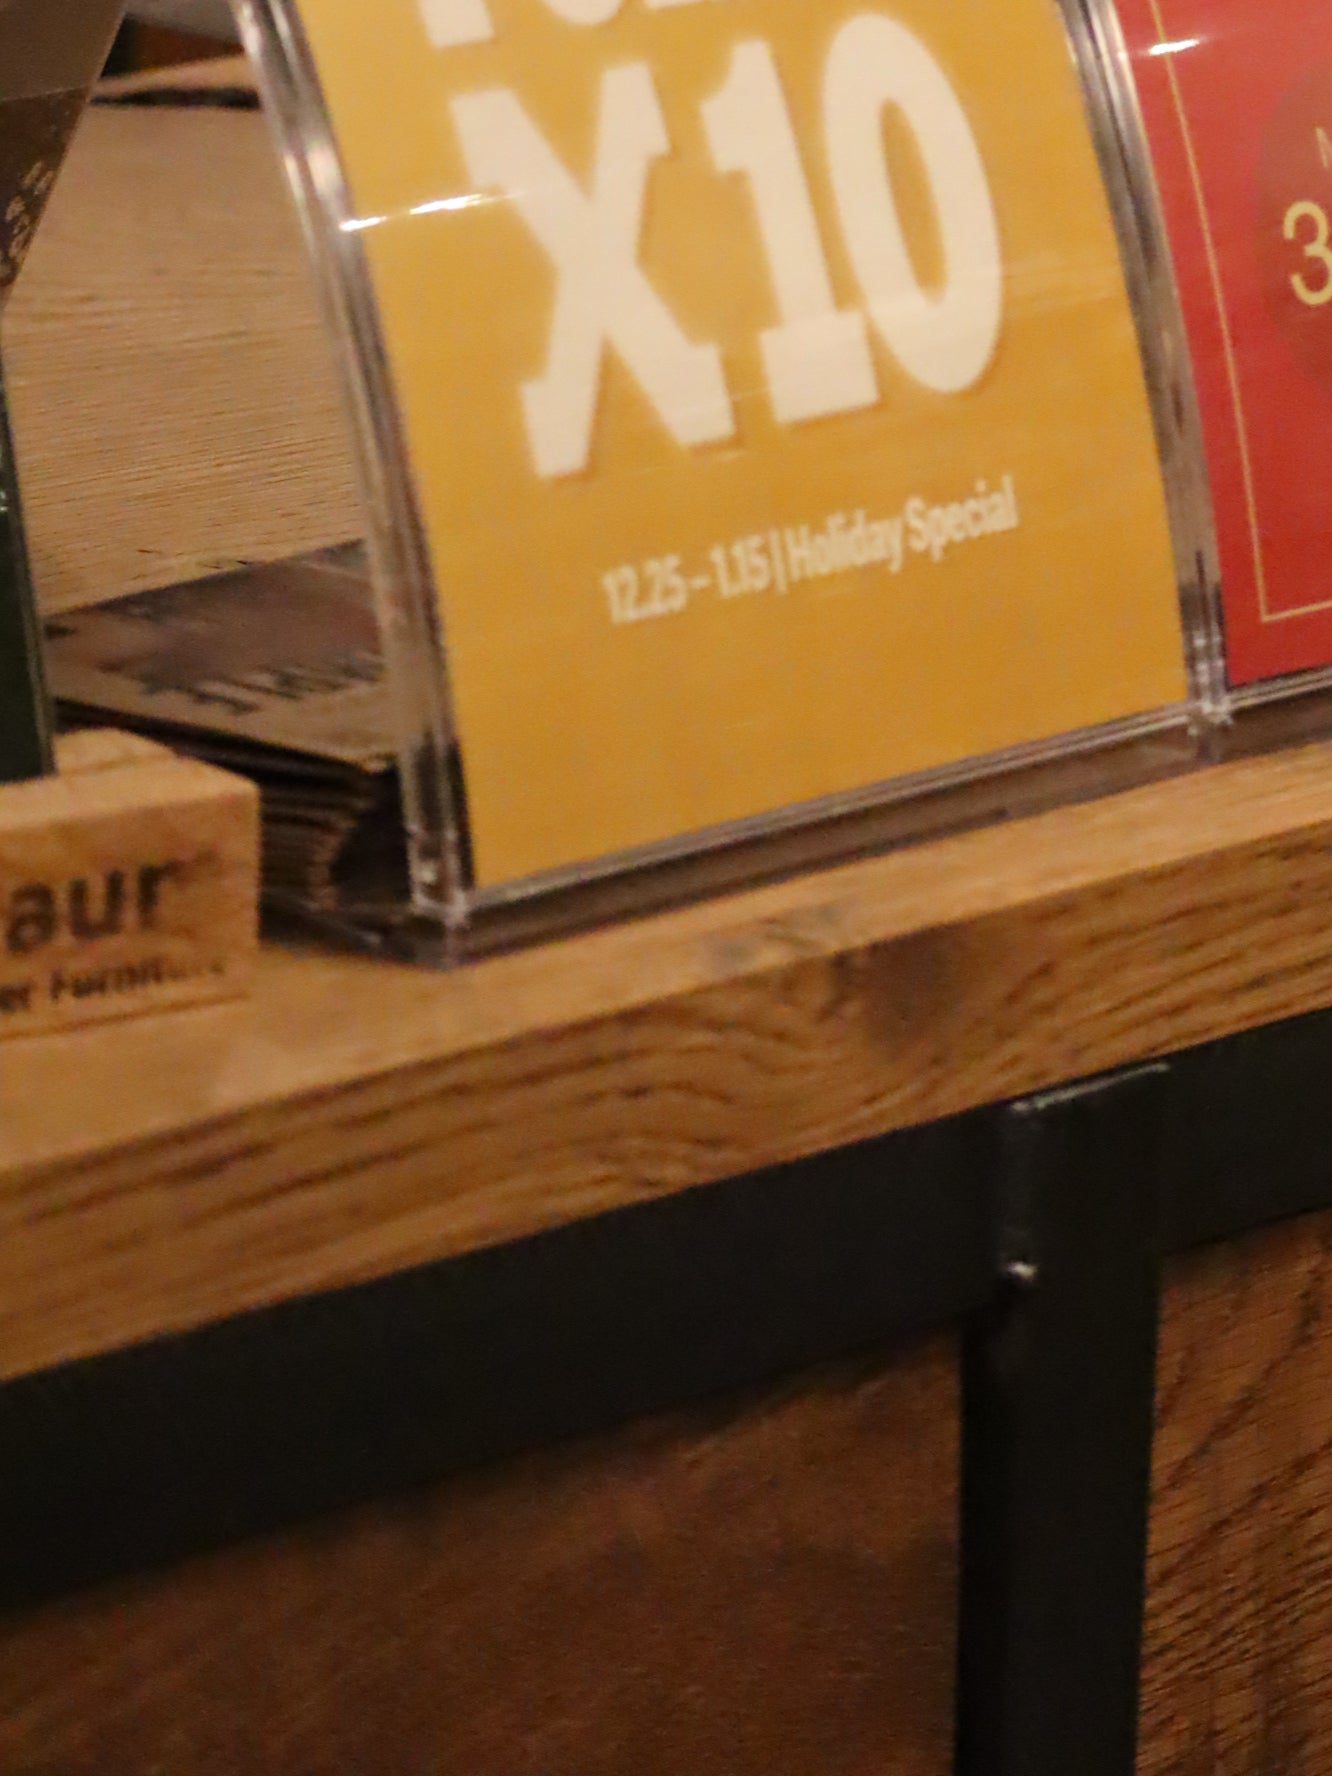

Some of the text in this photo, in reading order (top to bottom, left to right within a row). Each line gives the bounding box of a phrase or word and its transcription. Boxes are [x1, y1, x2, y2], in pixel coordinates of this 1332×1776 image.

[449, 12, 1006, 478] X10
[784, 508, 903, 584] Holiday
[905, 473, 1019, 562] Special
